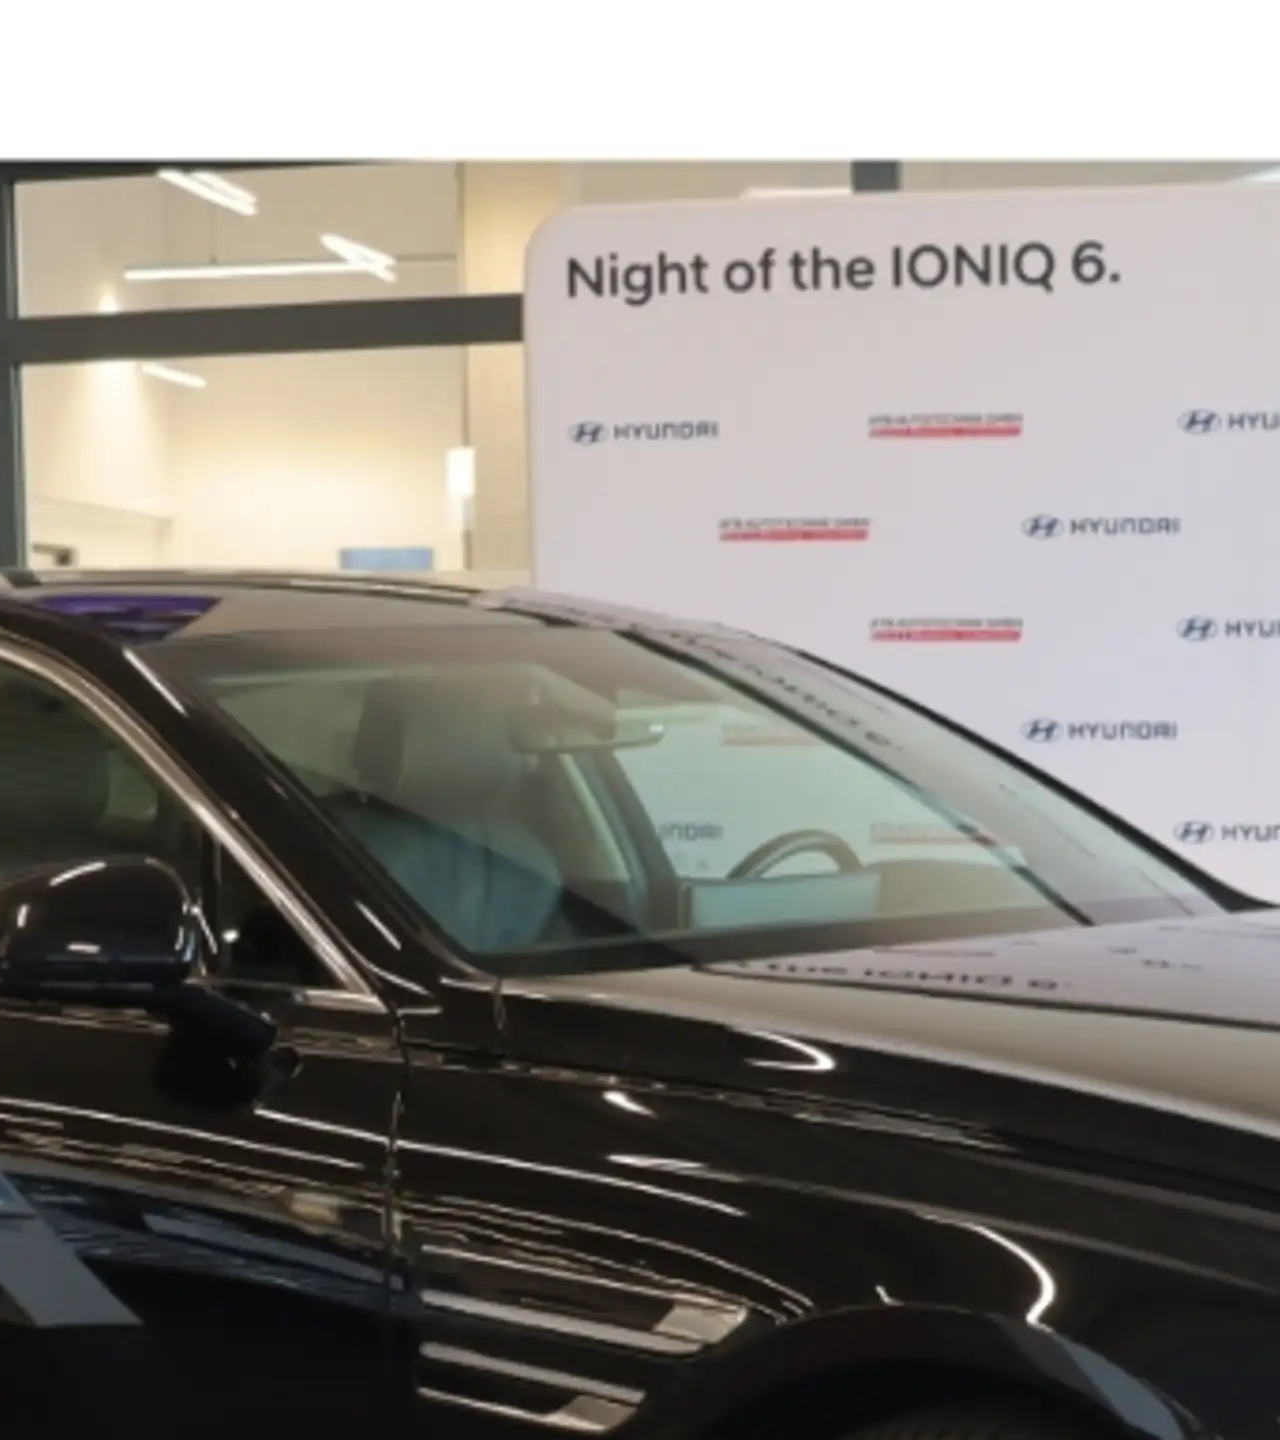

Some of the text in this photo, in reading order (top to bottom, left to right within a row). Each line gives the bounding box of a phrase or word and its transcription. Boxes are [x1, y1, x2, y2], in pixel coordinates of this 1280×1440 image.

[566, 240, 1122, 307] Night of the IONIQ 6.
[613, 420, 719, 441] HYUNDAI
[1069, 516, 1181, 536] HYUNDAI
[1067, 721, 1178, 741] HYUNDAI
